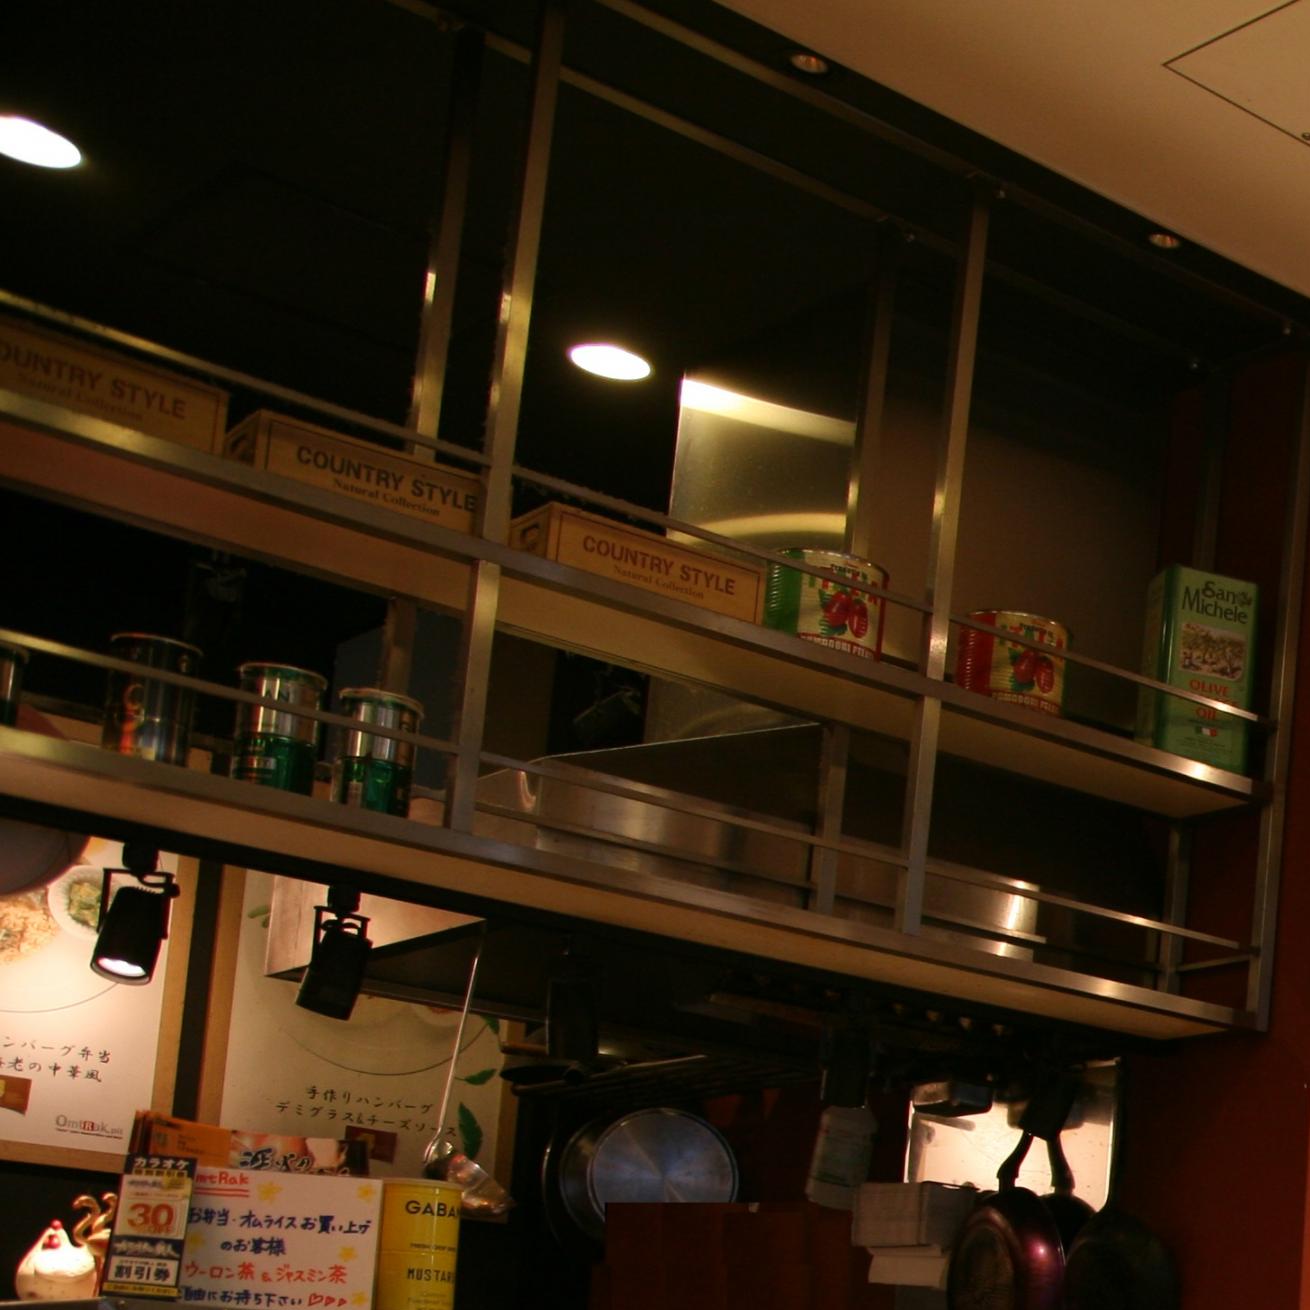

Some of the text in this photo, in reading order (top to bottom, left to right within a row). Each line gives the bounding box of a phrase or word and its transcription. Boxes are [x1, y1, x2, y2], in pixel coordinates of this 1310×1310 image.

[0, 340, 186, 420] OUNTRY STYLE
[297, 445, 477, 513] COUNTRY STYLE
[583, 535, 735, 596] COUNTRY STYLE
[1182, 586, 1249, 625] Michele
[1202, 581, 1236, 605] San
[305, 1085, 435, 1114] 手作りハンバーグ
[134, 1157, 190, 1171] カラオケ
[127, 1203, 174, 1227] 30
[405, 1200, 459, 1217] GABA
